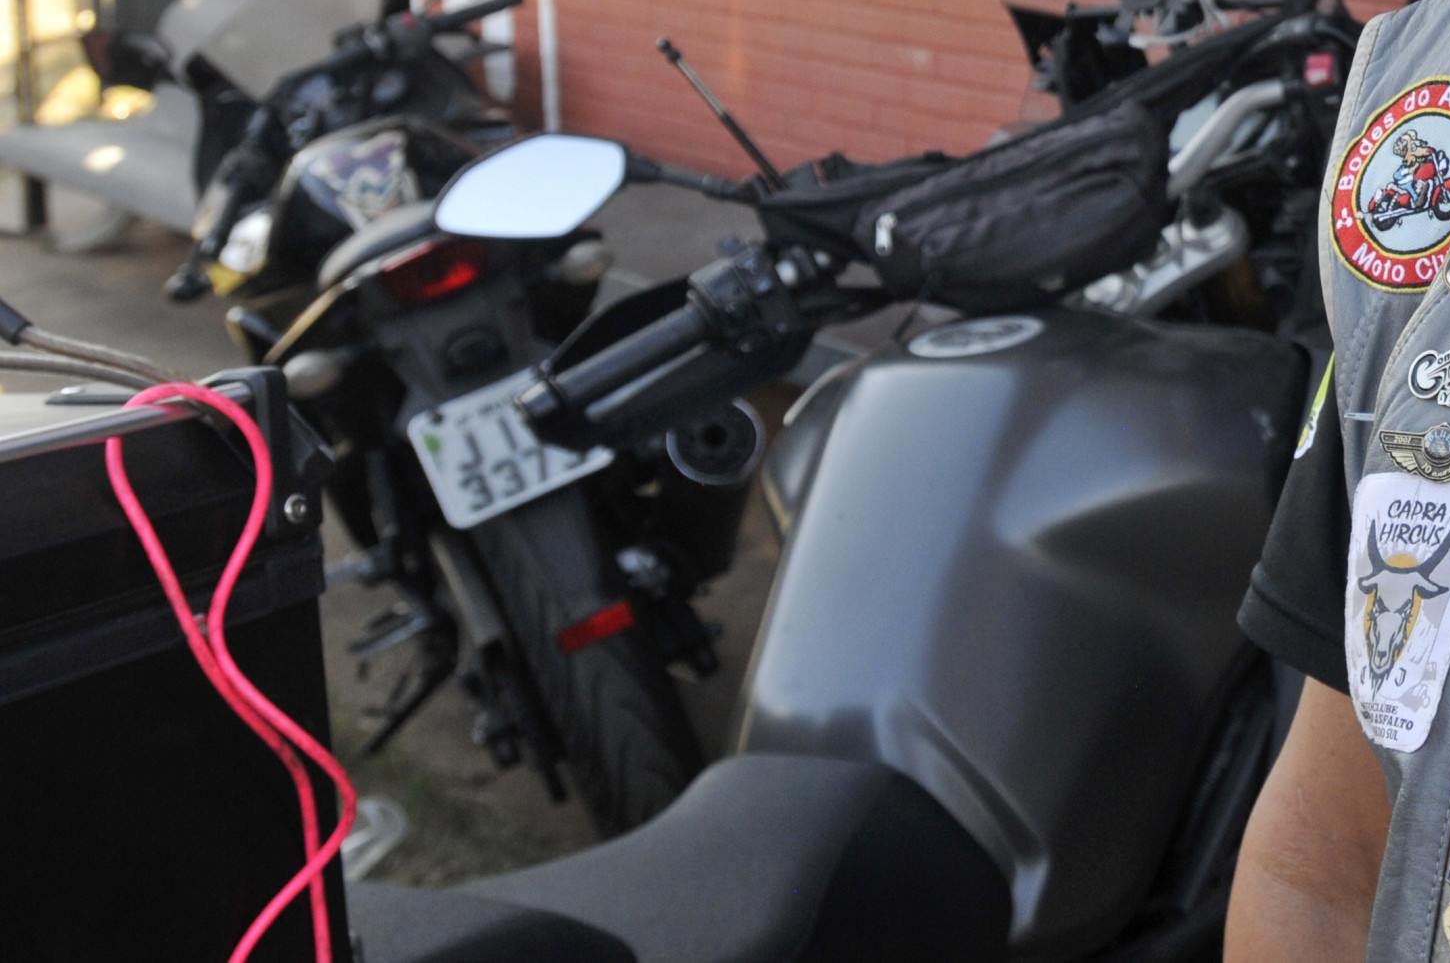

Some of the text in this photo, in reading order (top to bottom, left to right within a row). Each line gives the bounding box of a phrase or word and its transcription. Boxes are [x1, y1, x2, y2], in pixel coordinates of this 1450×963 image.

[1338, 112, 1395, 191] Bodes
[1404, 89, 1431, 112] do
[1352, 243, 1405, 282] Moto
[1421, 462, 1432, 474] 10
[1387, 499, 1448, 522] CAPRA
[1379, 522, 1446, 546] HIRCUS
